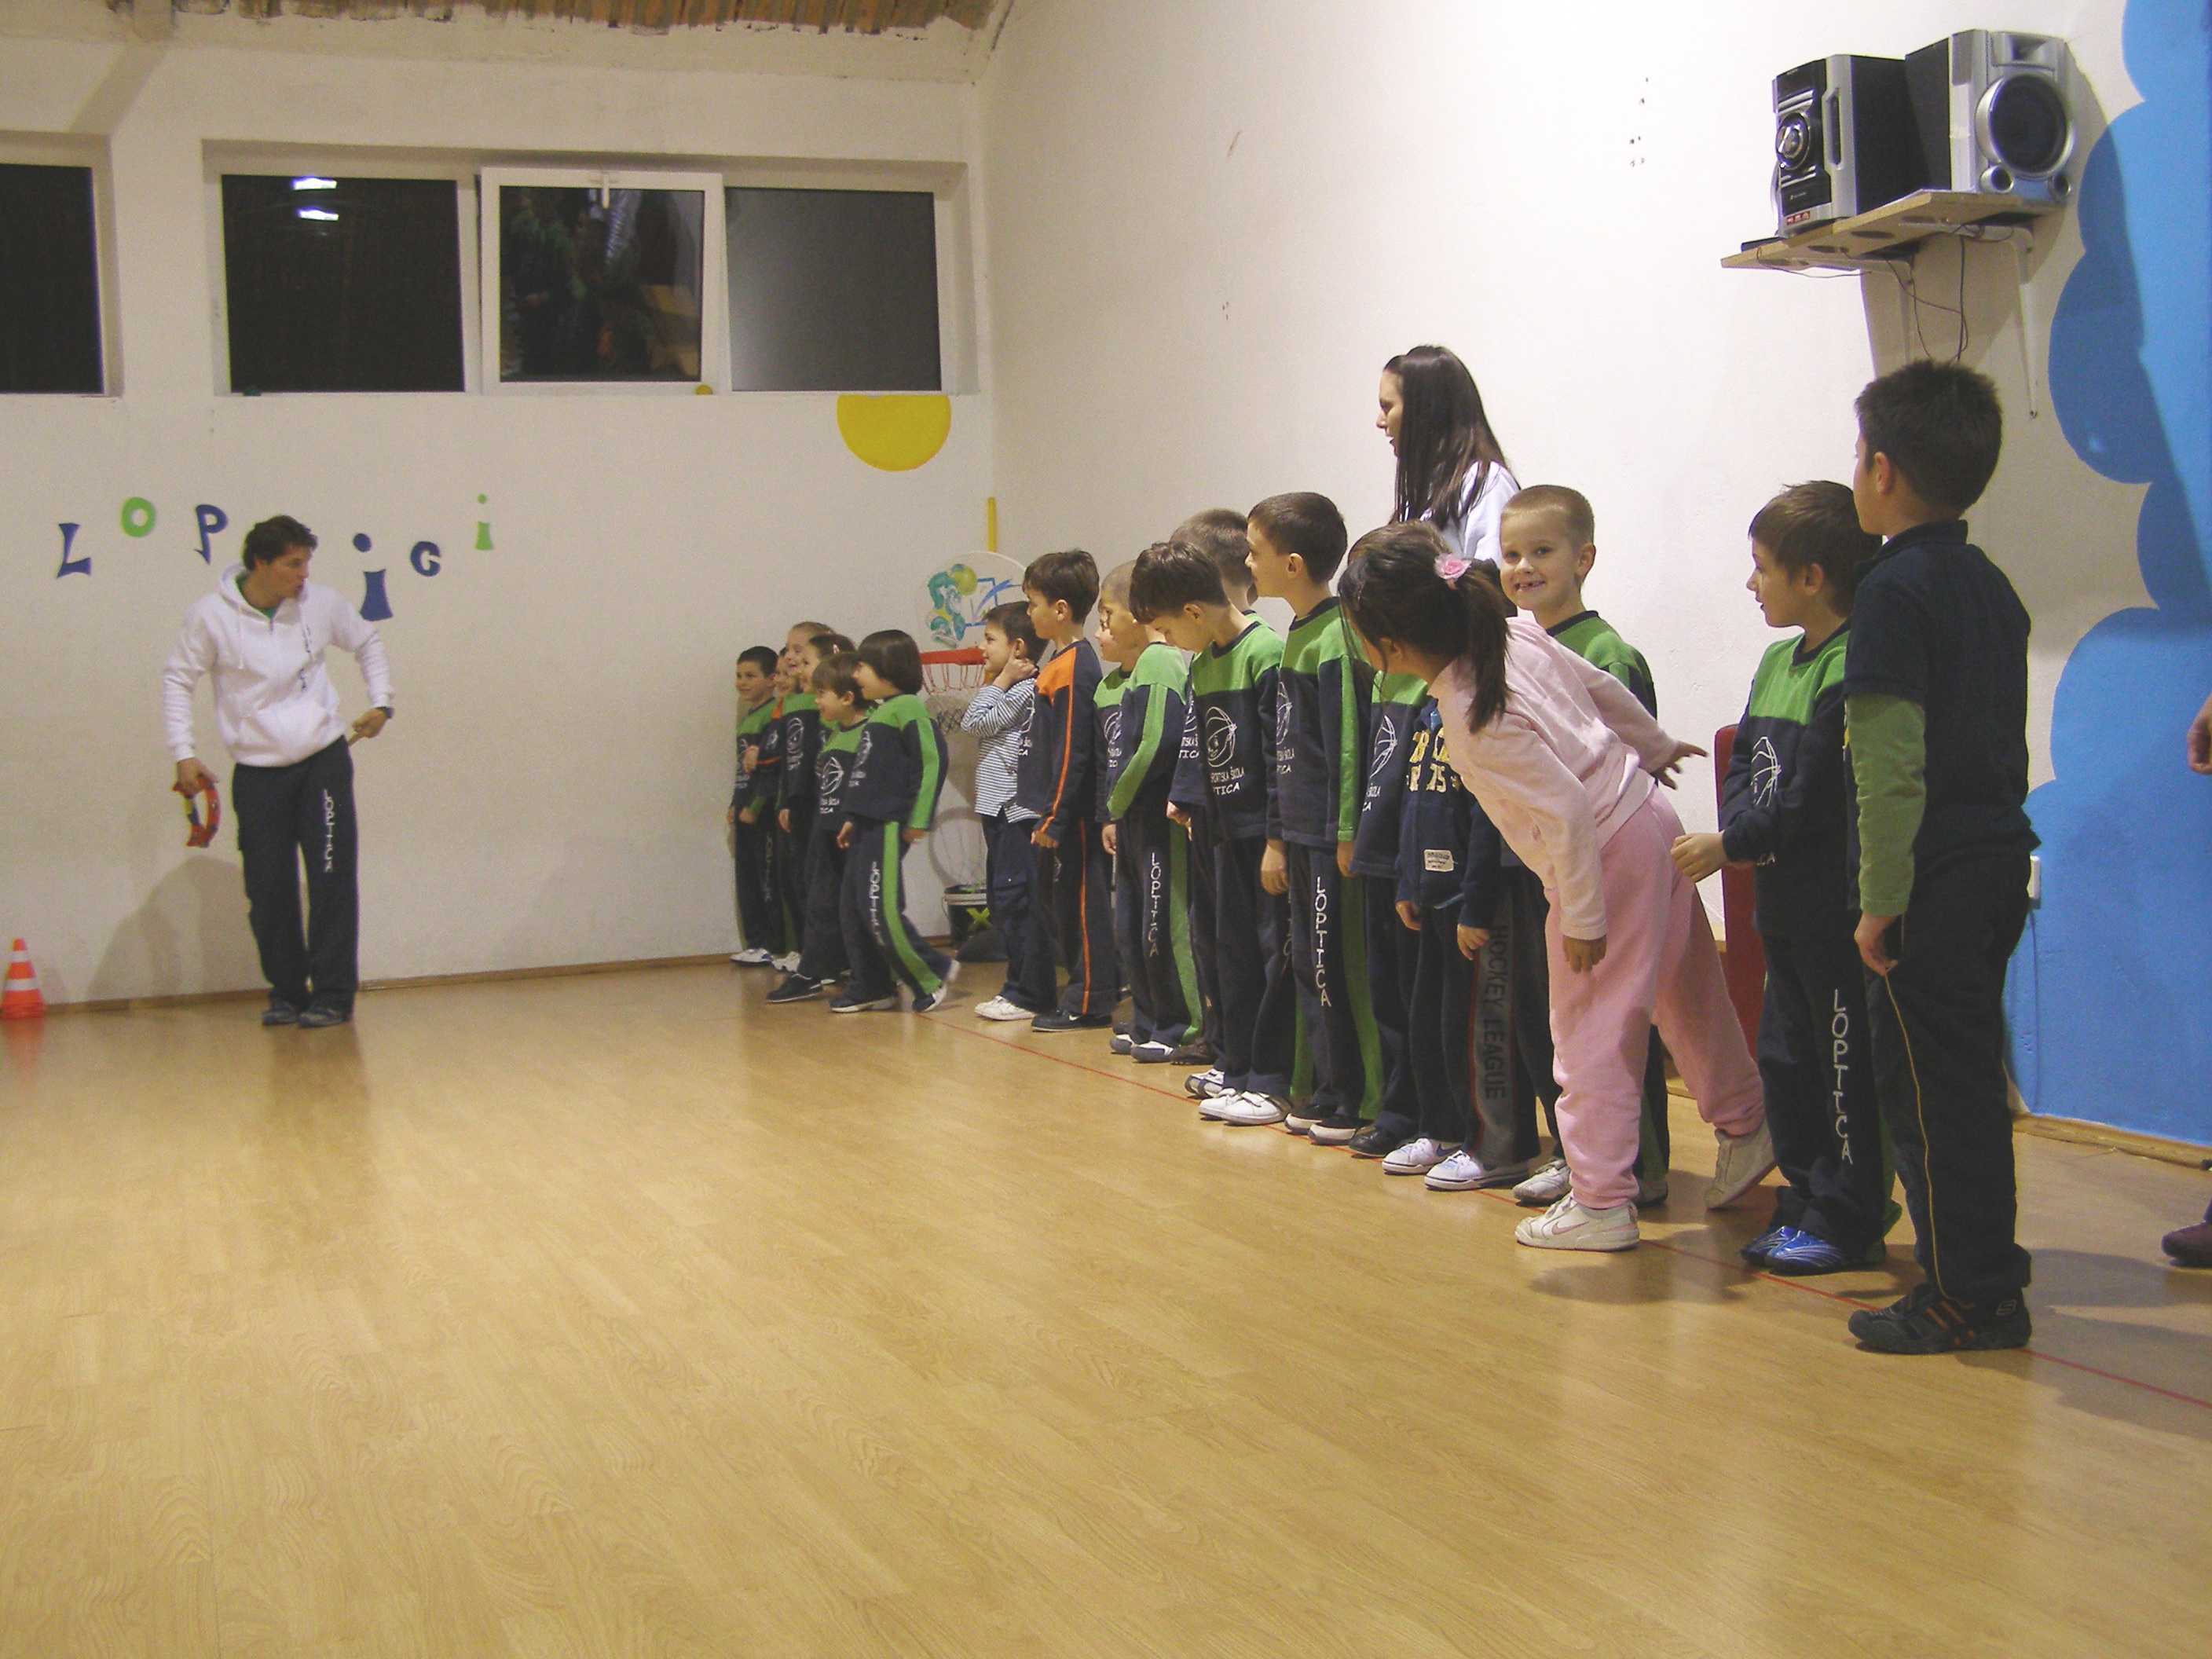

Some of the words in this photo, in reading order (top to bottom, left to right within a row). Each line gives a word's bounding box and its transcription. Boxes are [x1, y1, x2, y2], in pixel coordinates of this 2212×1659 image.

[1212, 782, 1241, 796] TICA
[1148, 852, 1162, 958] LOPTICA
[1314, 876, 1332, 1008] LOPTICA
[1483, 924, 1509, 1008] HOCKEY
[1483, 1018, 1507, 1100] LEAGUE
[1832, 988, 1853, 1166] LOPTICA
